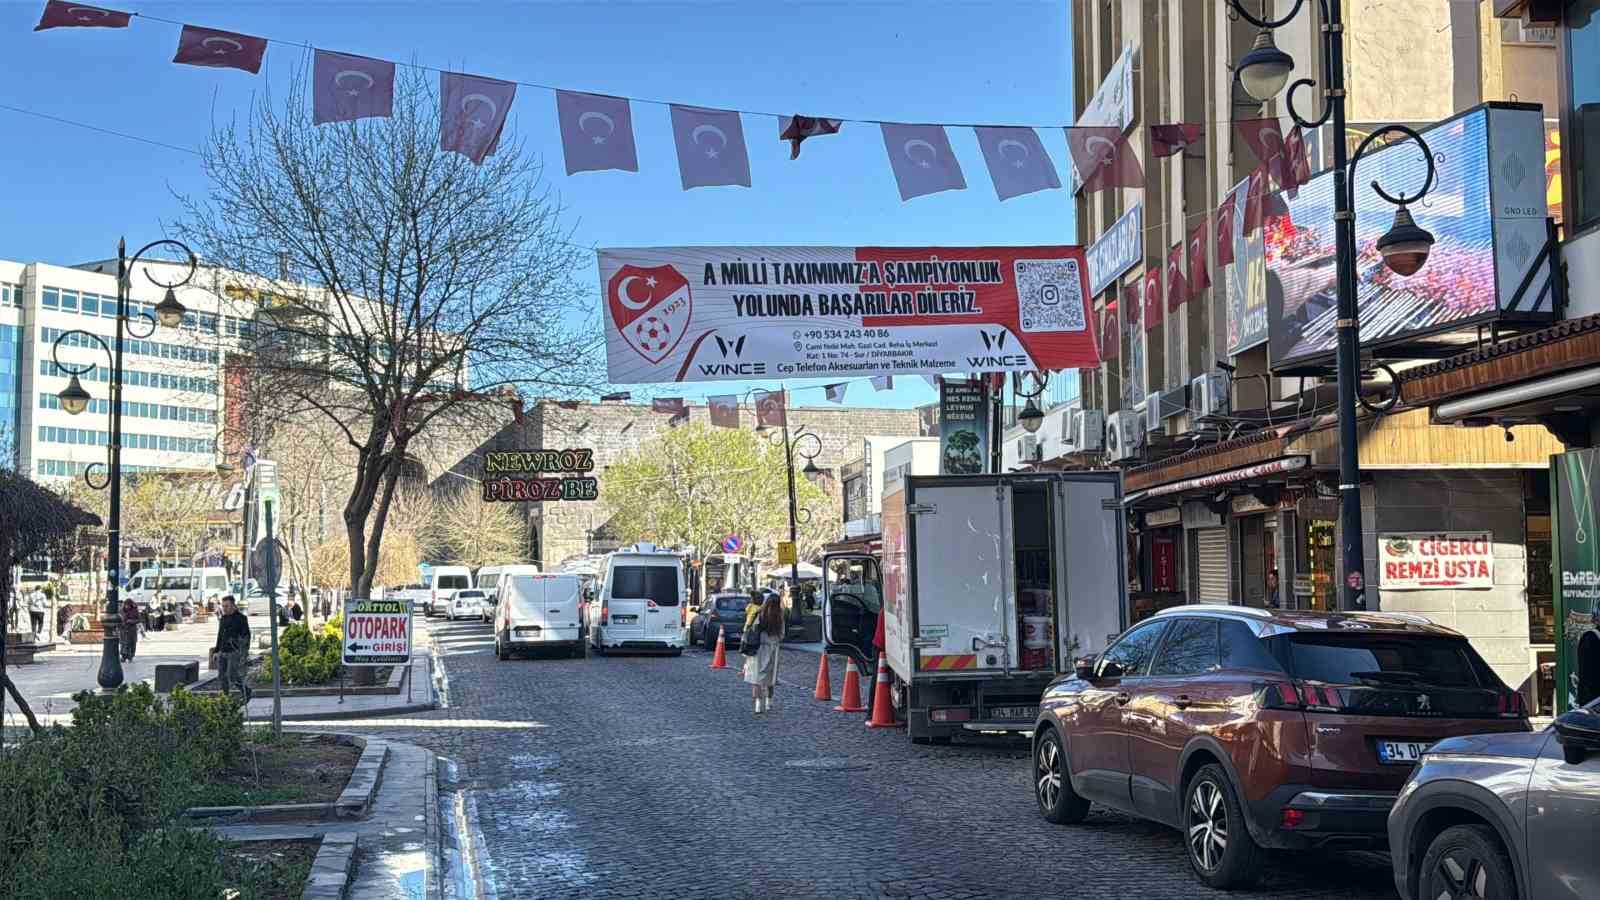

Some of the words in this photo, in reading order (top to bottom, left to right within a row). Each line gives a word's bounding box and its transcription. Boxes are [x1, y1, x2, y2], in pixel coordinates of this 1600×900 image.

[703, 262, 717, 285] A
[720, 257, 768, 285] MİLLİ
[771, 262, 881, 284] TAKIMIMIZ'A
[884, 256, 1002, 287] ŞAMPİYONLUK
[662, 297, 687, 315] 1923
[732, 294, 815, 317] YOLUNDA
[818, 292, 913, 319] BAŞARILAR
[916, 287, 982, 315] DİLERİZ.
[804, 330, 822, 340] +90
[824, 329, 842, 339] 534
[844, 329, 862, 339] 243
[863, 329, 875, 338] 40
[877, 328, 890, 338] 86
[698, 363, 766, 375] WINCE
[776, 362, 794, 373] Cep
[795, 362, 827, 372] Telefon
[880, 362, 891, 370] ve
[891, 359, 919, 369] Teknik
[920, 359, 956, 369] Malzeme
[966, 355, 1027, 367] WINCE
[484, 450, 594, 473] NEWROZ
[1418, 534, 1489, 556] CİĞERCİ
[1384, 558, 1440, 579] REMZİ
[1444, 560, 1490, 578] USTA
[348, 616, 408, 639] OTOPARK
[1386, 743, 1405, 759] 34
